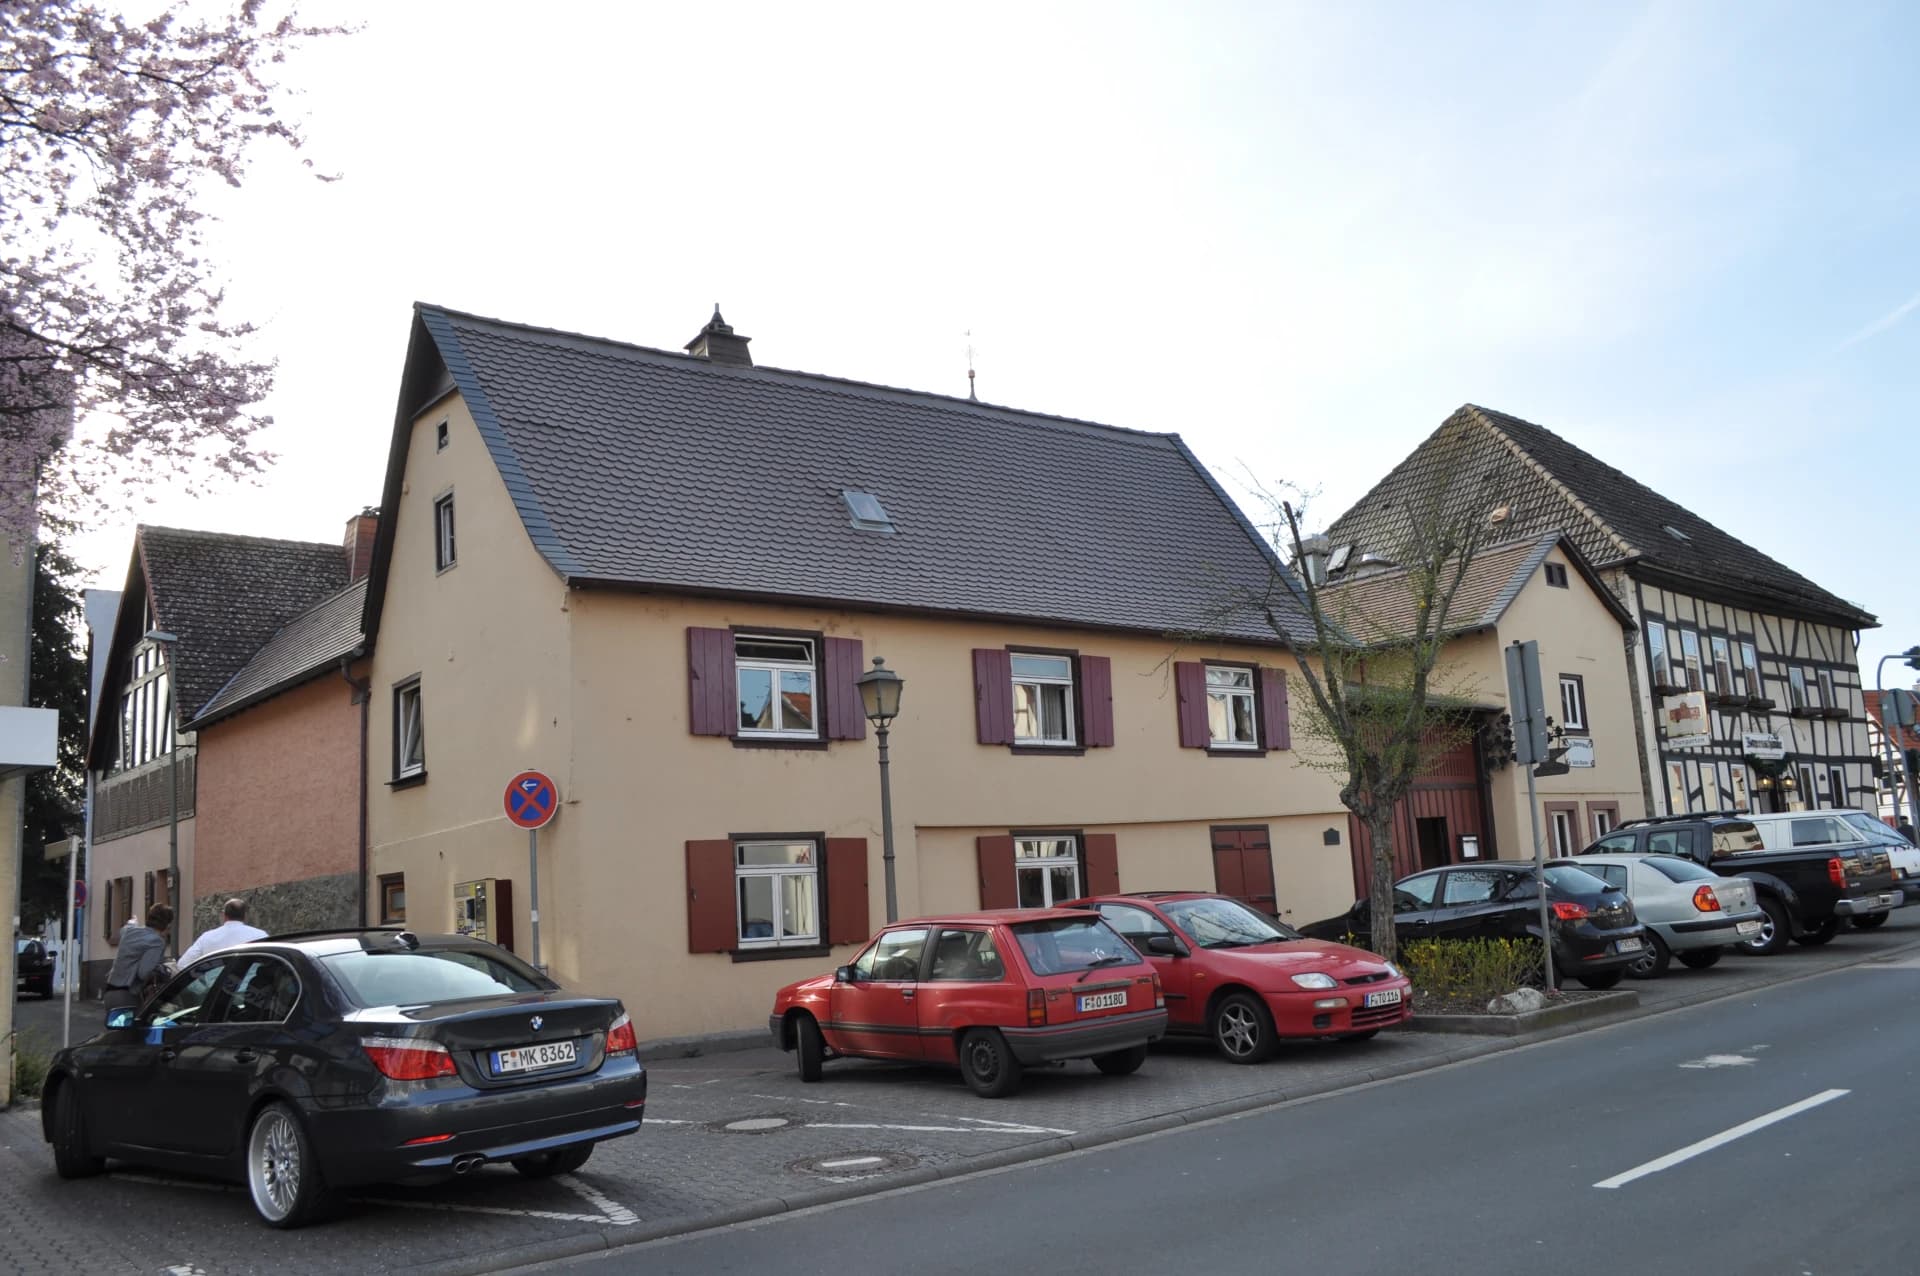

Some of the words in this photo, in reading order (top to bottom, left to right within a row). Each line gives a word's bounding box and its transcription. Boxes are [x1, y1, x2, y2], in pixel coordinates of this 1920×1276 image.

[1103, 993, 1124, 1007] 1180
[501, 1052, 509, 1069] F
[519, 1048, 538, 1066] MK
[540, 1043, 574, 1063] 8362
